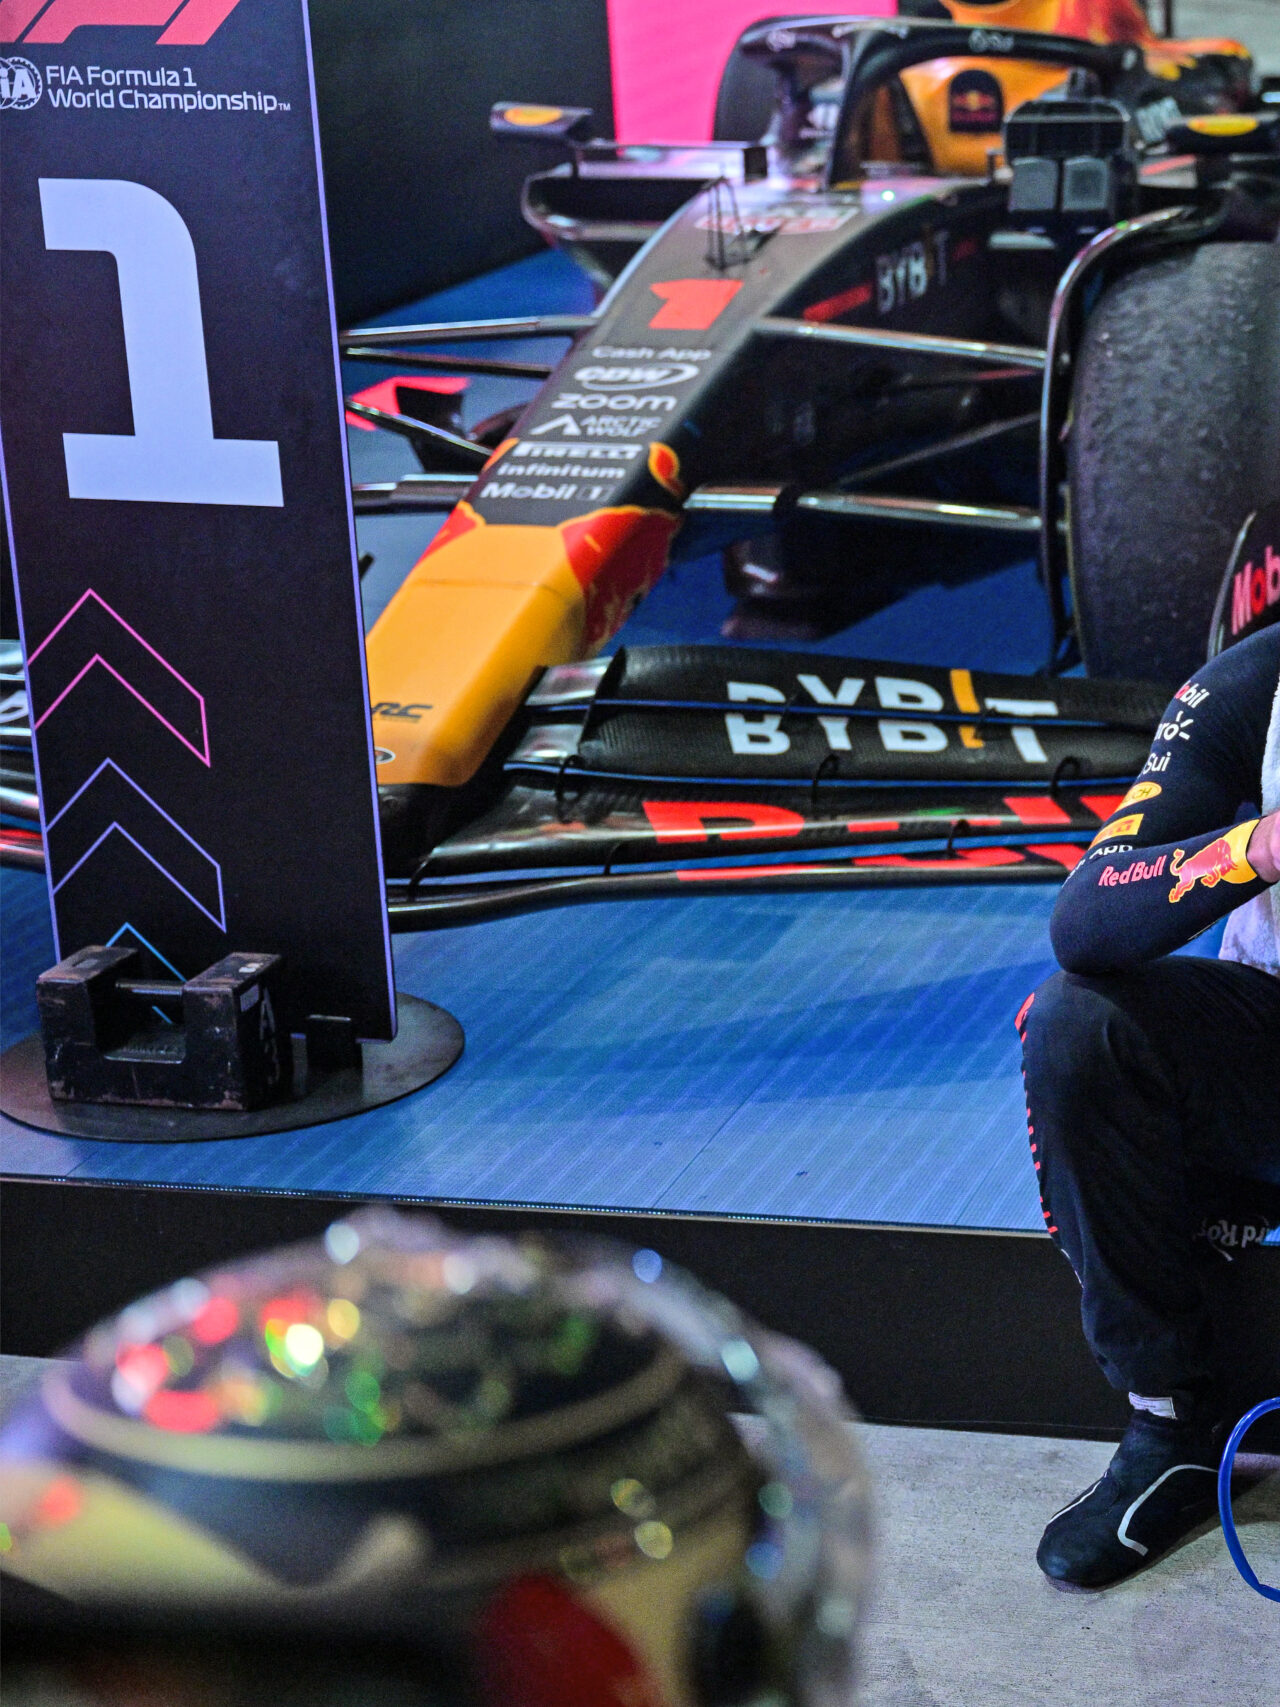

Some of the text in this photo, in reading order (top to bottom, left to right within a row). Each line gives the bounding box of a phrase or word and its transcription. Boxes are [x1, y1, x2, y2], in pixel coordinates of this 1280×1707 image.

[46, 65, 198, 87] FIA Formula 1
[48, 88, 114, 109] World
[118, 90, 278, 114] Championship
[648, 277, 744, 331] 1
[38, 176, 285, 508] 1
[591, 345, 712, 361] Cash App
[551, 392, 678, 412] zoom
[580, 413, 663, 428] ARCTIC
[586, 426, 654, 438] WOLF
[512, 441, 644, 460] PIRELLI
[496, 463, 627, 480] infinitum
[480, 482, 578, 501] Mobil
[1175, 681, 1210, 708] obil
[724, 668, 1059, 764] BYBIT
[1144, 751, 1172, 775] Sui
